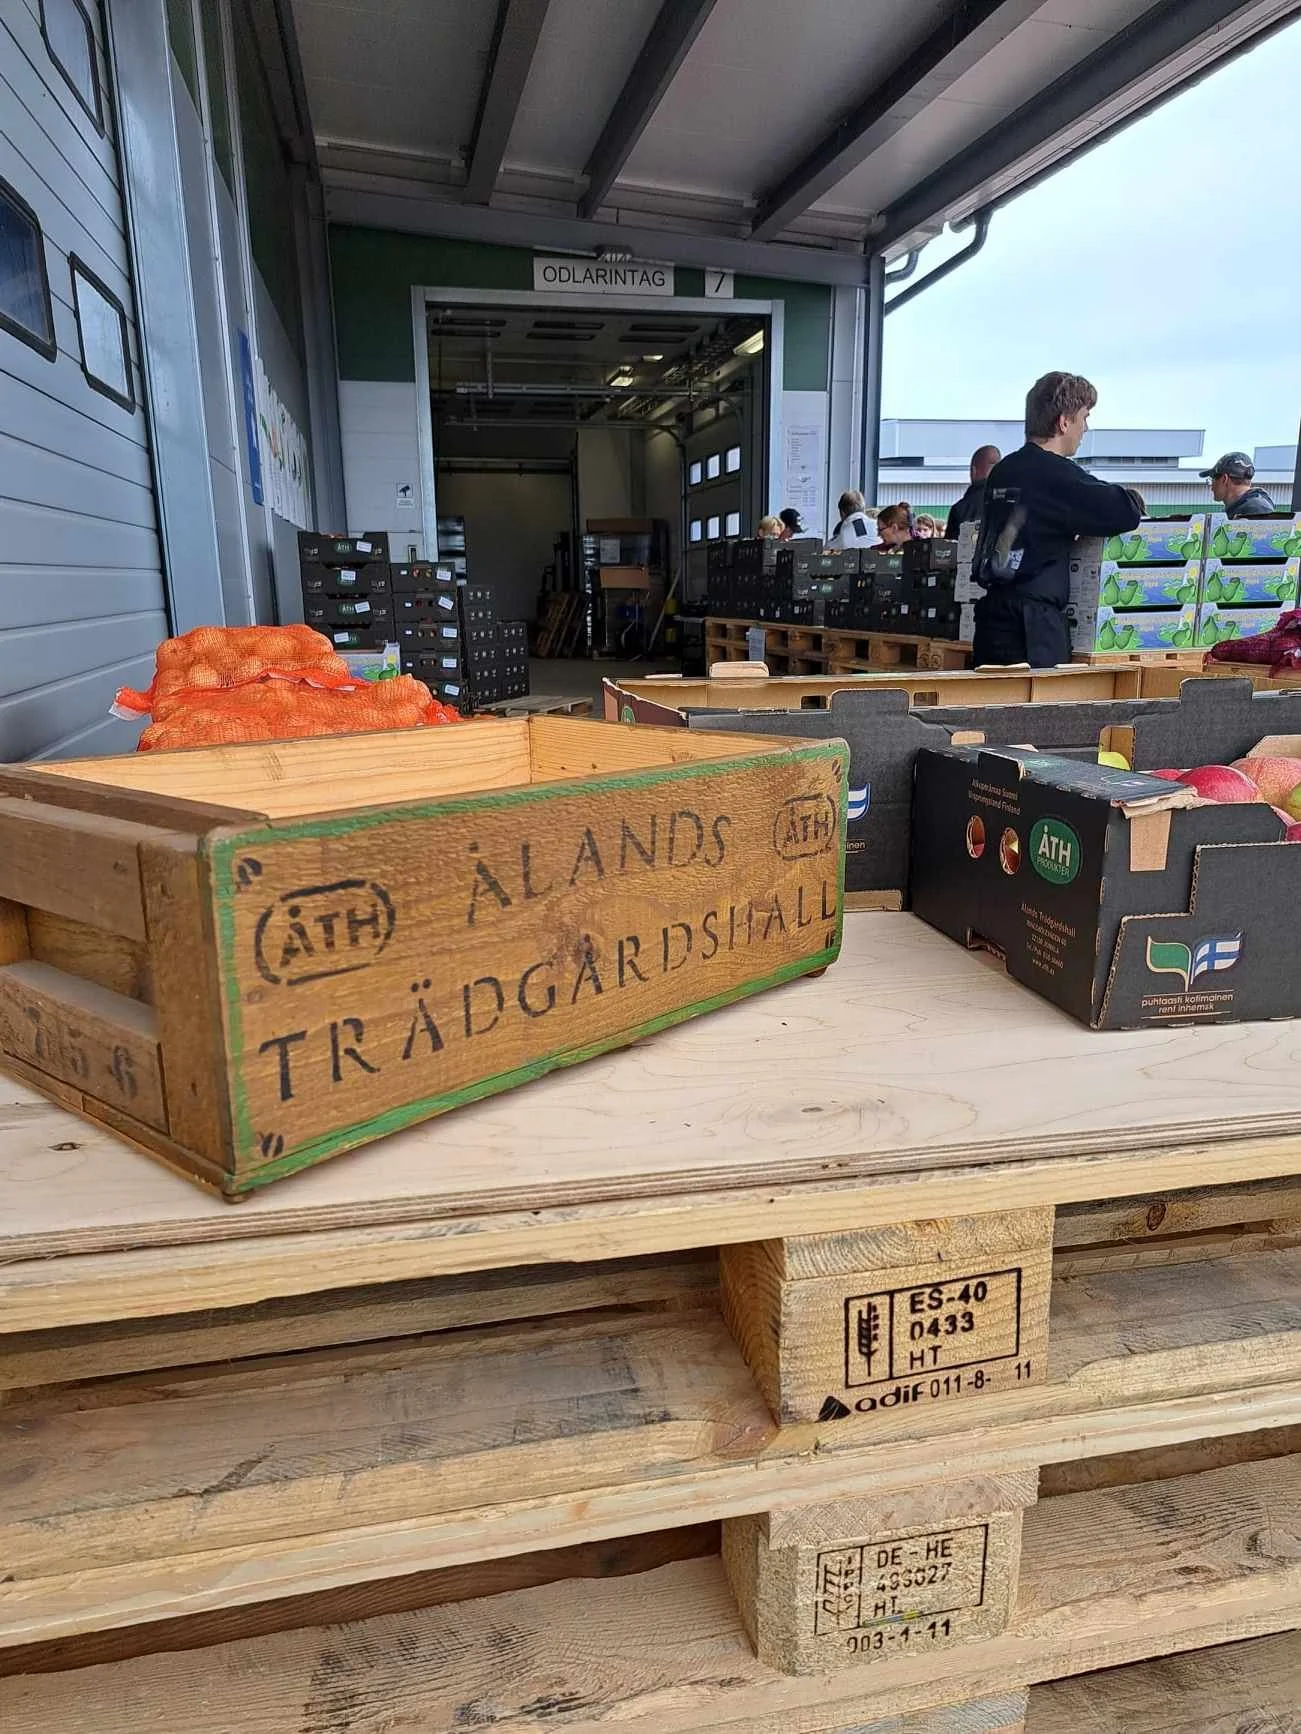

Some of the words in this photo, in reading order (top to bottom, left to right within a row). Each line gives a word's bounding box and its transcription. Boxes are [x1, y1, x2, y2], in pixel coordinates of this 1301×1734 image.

[543, 265, 666, 287] ODLARINTAG
[711, 271, 726, 293] 7
[783, 797, 831, 845] ÅTH
[846, 841, 865, 850] inen
[1038, 825, 1071, 867] ÅTH
[466, 810, 732, 928] ÅLANDS
[281, 904, 381, 967] ÅTH
[259, 880, 836, 1102] TRÄDGÅRDSHALL
[1141, 995, 1183, 1009] puhtaasti
[1185, 993, 1234, 1004] kotimainen
[1158, 1005, 1176, 1014] rent
[1178, 1003, 1214, 1012] inhemsk
[909, 1280, 988, 1314] ES-40
[909, 1311, 975, 1341] 0433
[909, 1345, 942, 1370] HT
[1014, 1360, 1031, 1381] 11
[873, 1595, 898, 1618] HT
